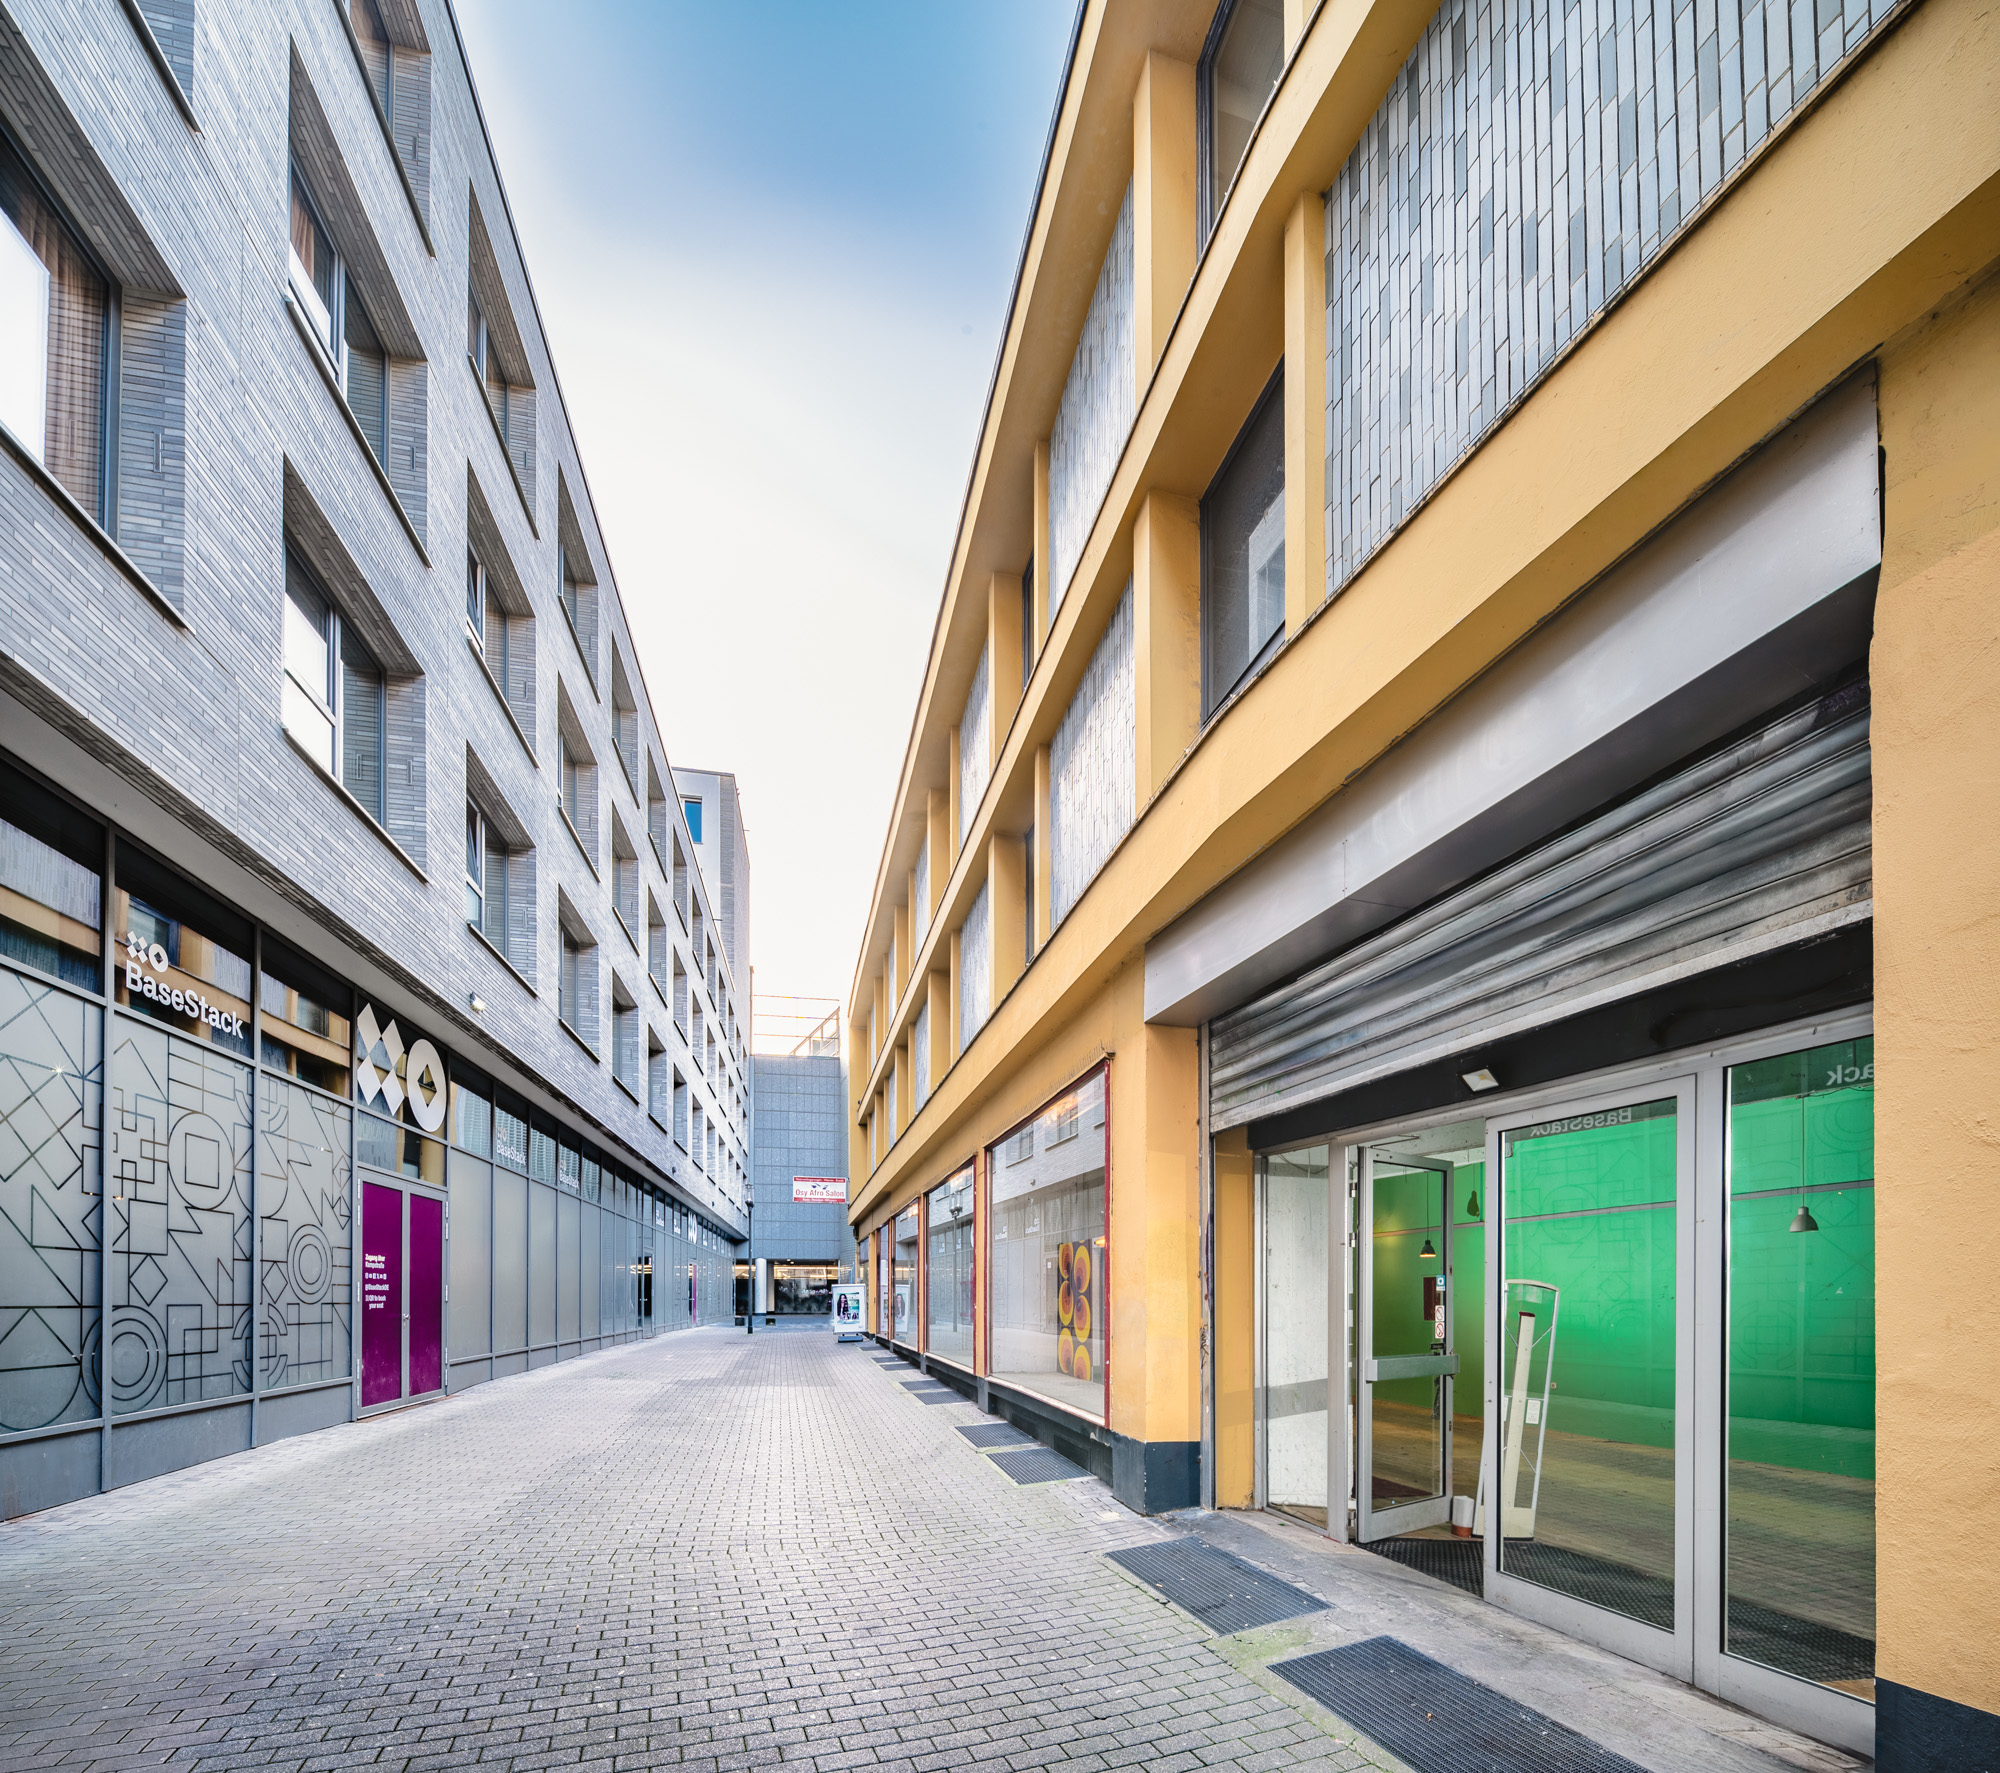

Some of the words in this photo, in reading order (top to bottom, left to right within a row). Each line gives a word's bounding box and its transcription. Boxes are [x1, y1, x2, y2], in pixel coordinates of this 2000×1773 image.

[126, 959, 244, 1039] BaseStack
[496, 1139, 527, 1166] BaseStack
[559, 1170, 580, 1190] BaseStack
